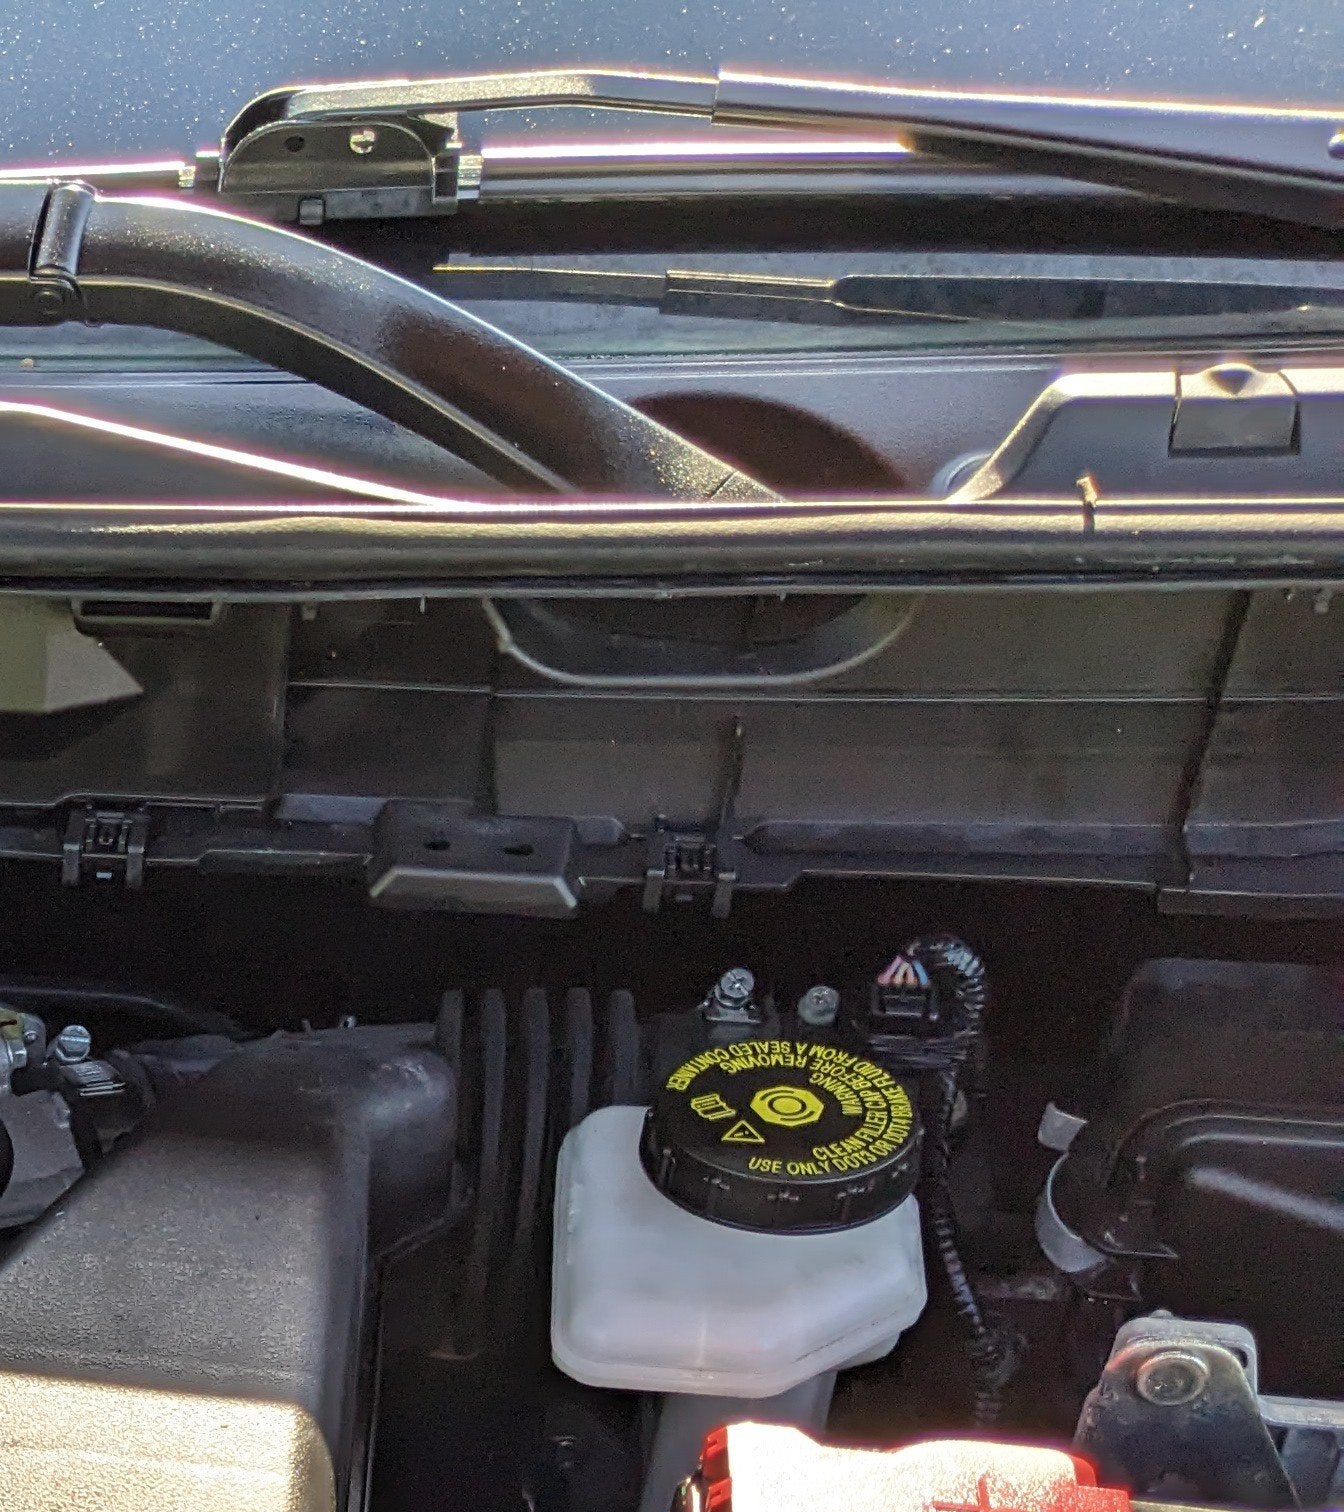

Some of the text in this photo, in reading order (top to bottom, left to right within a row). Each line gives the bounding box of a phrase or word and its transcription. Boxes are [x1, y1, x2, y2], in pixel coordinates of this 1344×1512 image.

[728, 1041, 792, 1056] SEALED
[795, 1042, 808, 1055] A
[809, 1045, 858, 1067] FROM
[853, 1061, 896, 1087] FLUID
[809, 1072, 863, 1115] WARNING
[881, 1085, 913, 1117] BRAKE
[719, 1053, 888, 1160] CLEAN FILLER CAP BEFORE REMOVING
[869, 1140, 897, 1156] OR
[748, 1157, 783, 1174] USE
[786, 1160, 831, 1175] ONLY
